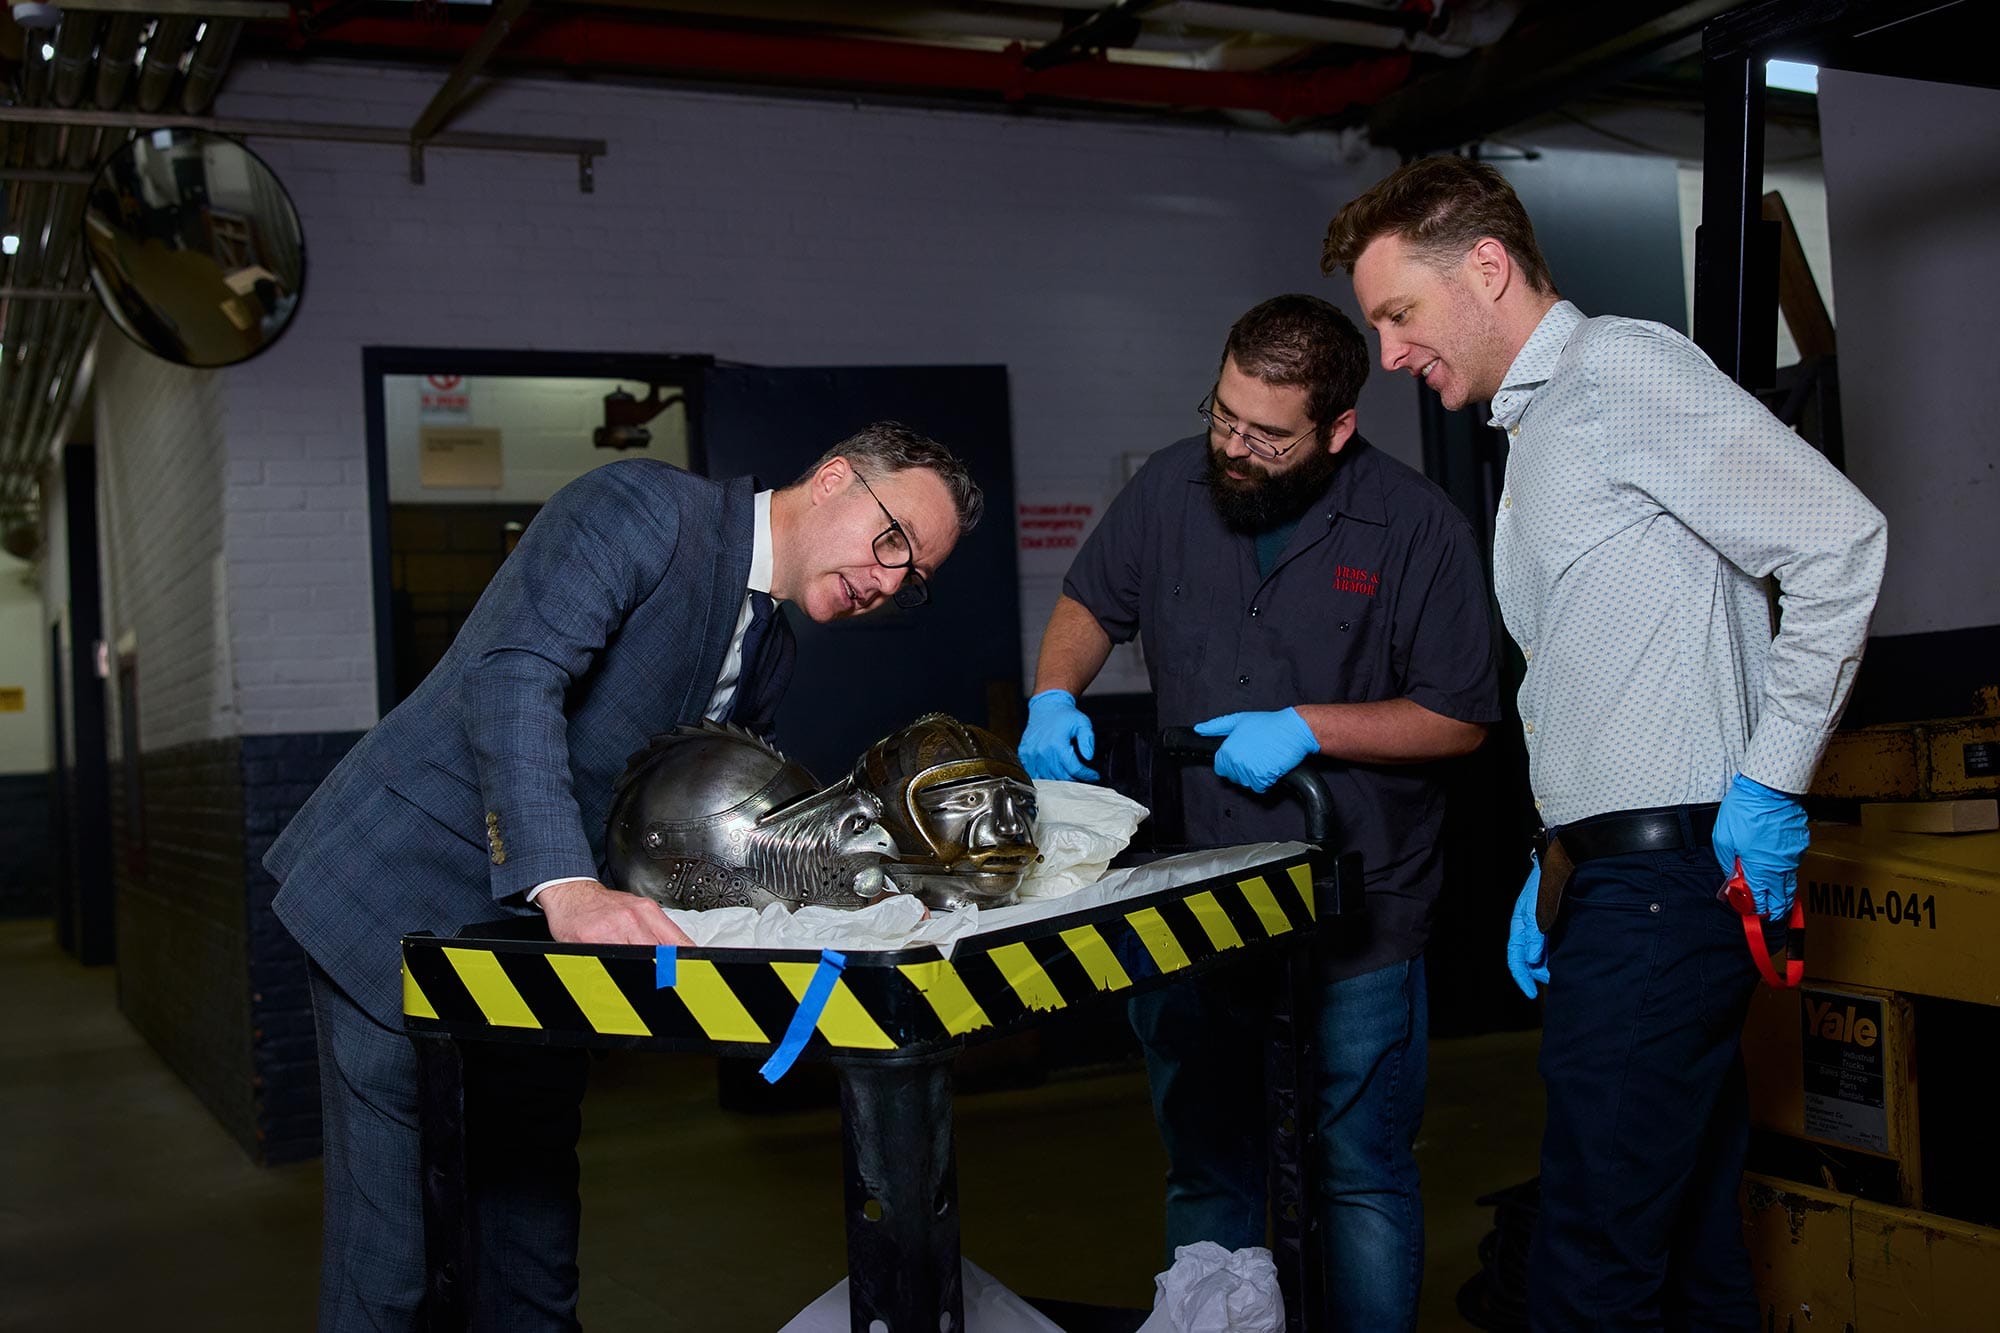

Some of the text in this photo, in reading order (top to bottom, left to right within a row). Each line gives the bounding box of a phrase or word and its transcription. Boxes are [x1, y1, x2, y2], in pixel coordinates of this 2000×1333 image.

[1333, 577, 1376, 596] ARMOR
[1335, 565, 1367, 581] ARMS
[1808, 881, 1937, 930] MMA-041
[1803, 997, 1878, 1048] Yale
